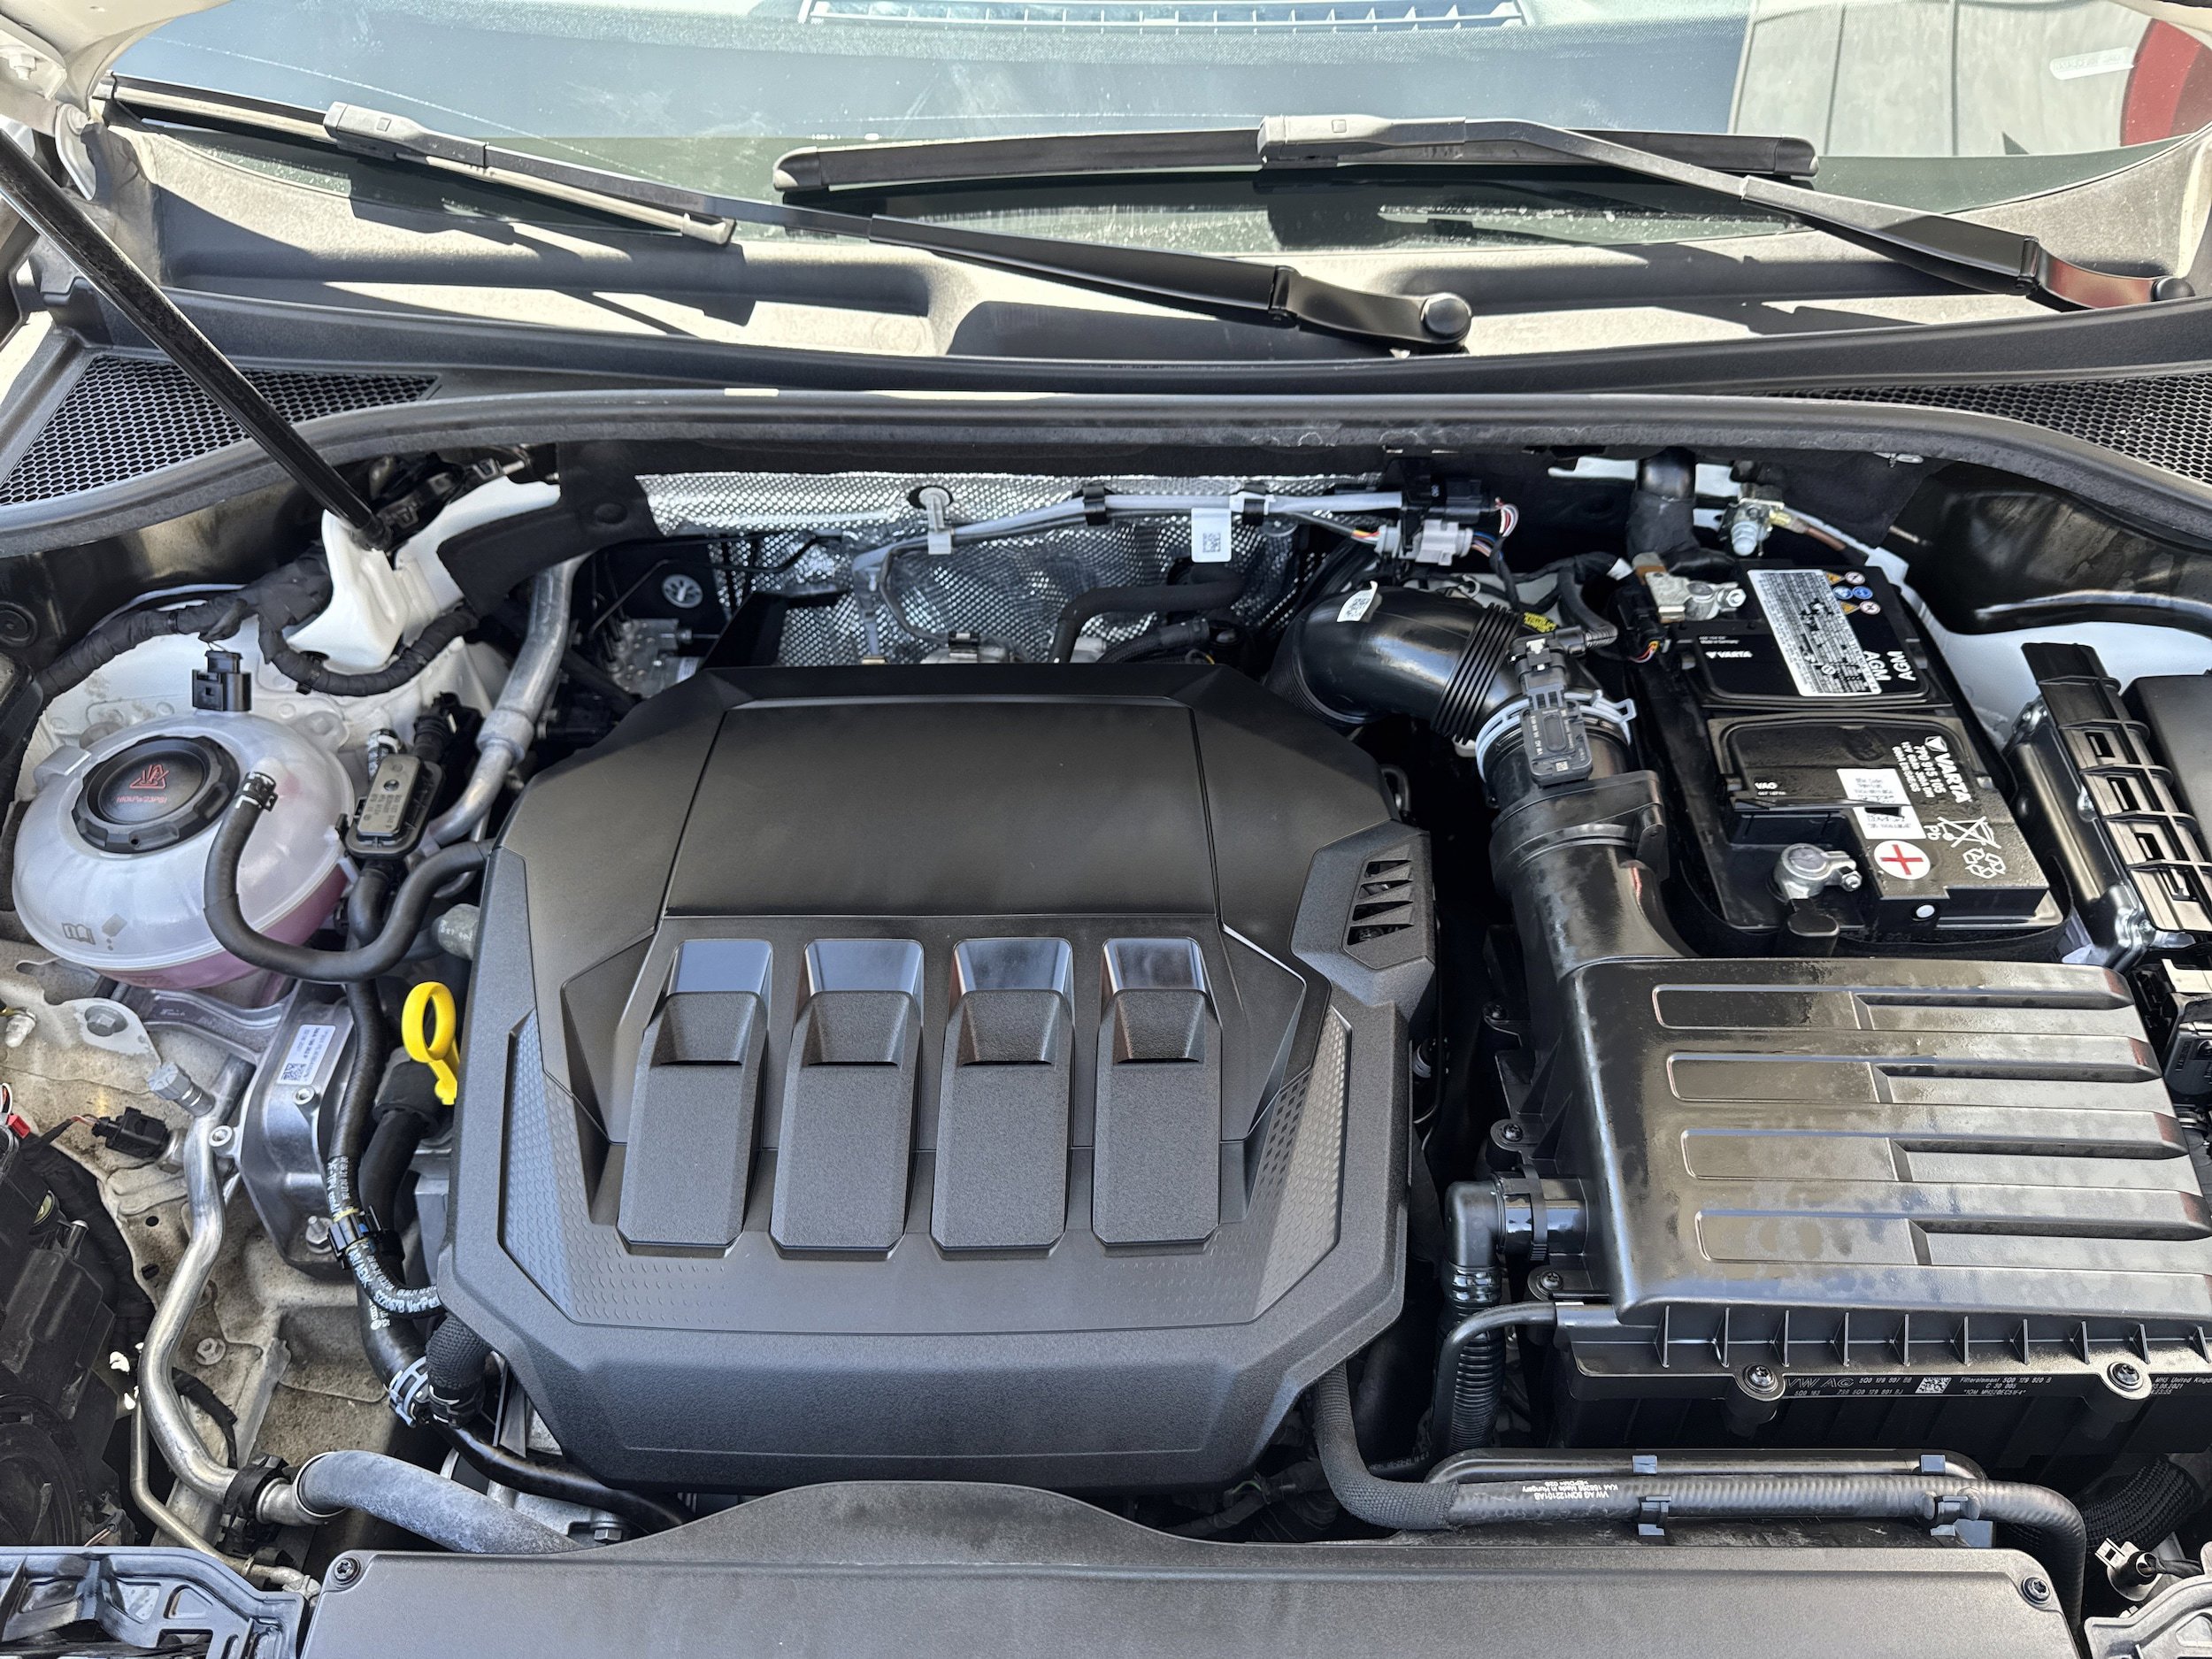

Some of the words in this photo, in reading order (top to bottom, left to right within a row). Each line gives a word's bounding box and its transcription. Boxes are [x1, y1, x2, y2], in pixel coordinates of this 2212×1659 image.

[1863, 650, 1892, 680] AGM
[1886, 651, 1916, 681] AGM
[1921, 761, 1939, 777] 915
[1930, 778, 1947, 794] 105
[1934, 753, 1971, 803] VARTA
[1924, 825, 1942, 841] Pb
[1786, 1378, 1820, 1388] VW
[1820, 1378, 1855, 1388] AG
